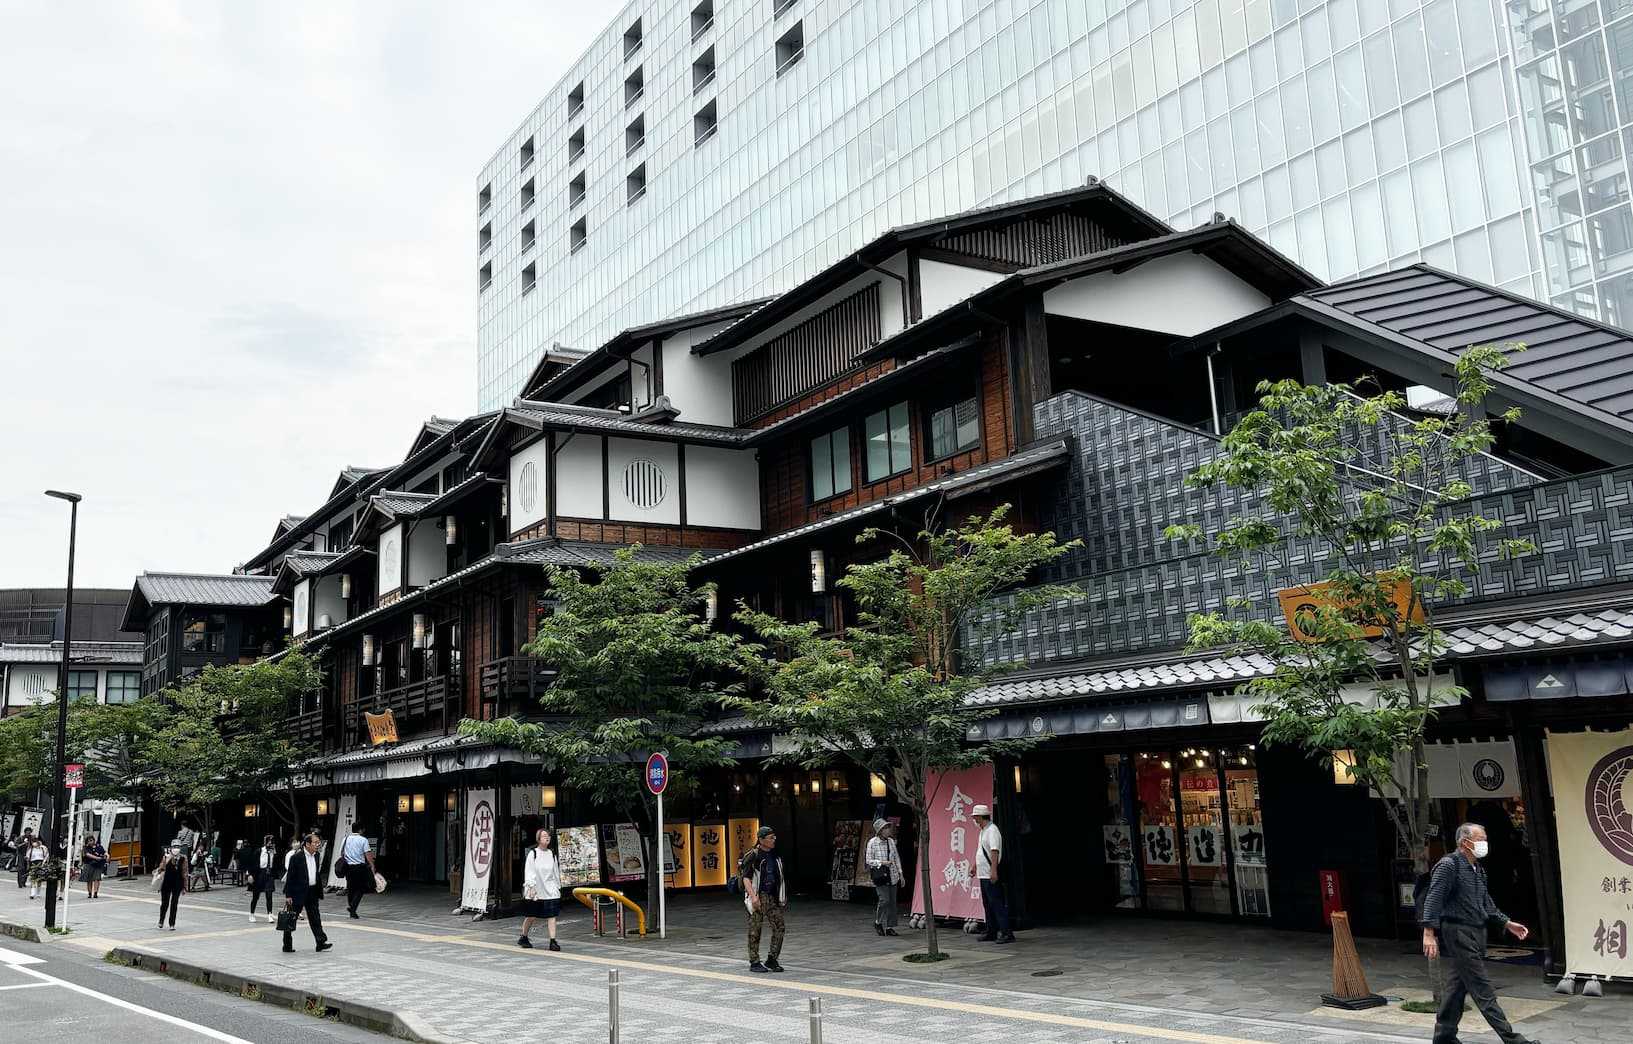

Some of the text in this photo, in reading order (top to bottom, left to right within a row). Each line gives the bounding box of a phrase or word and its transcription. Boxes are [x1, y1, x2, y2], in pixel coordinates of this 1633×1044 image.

[700, 829, 720, 870] 地酒
[940, 784, 974, 893] 金目鯛
[1600, 876, 1632, 894] 創業
[1593, 918, 1627, 960] 相
